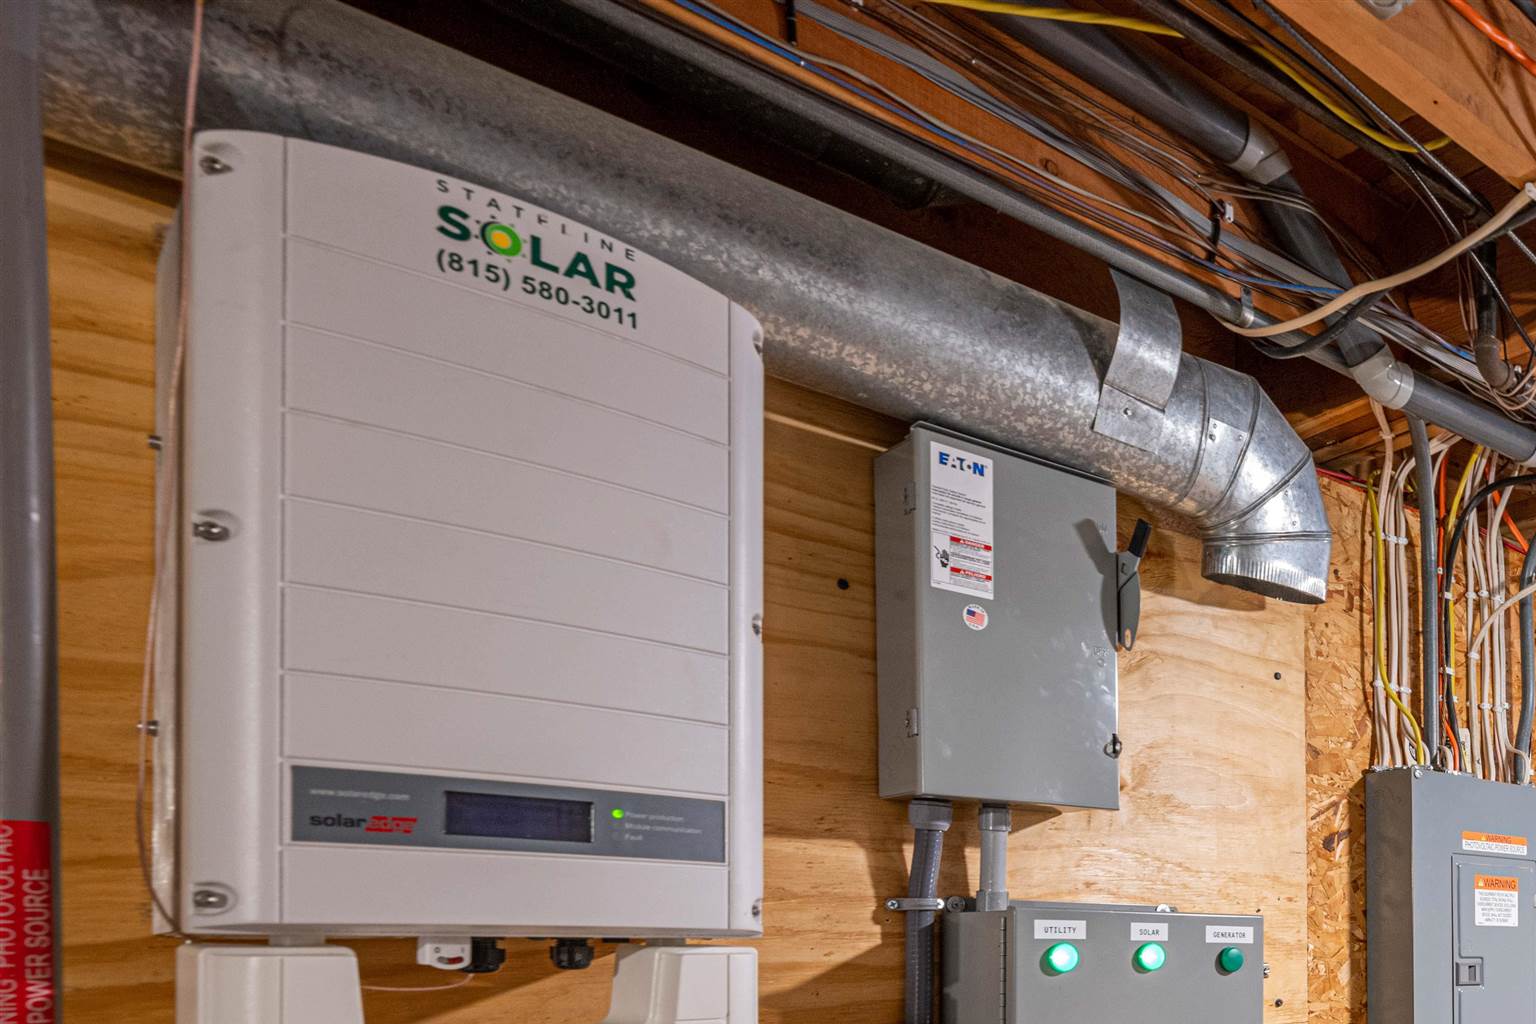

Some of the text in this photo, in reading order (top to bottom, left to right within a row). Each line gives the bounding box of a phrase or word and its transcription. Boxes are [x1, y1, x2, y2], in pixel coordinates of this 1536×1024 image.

[436, 204, 636, 302] SOLAR
[437, 249, 638, 329] (815) 580-3011
[1484, 878, 1517, 889] WARNING
[1043, 926, 1077, 935] UTILITY
[1139, 928, 1160, 937] SOLAR
[1212, 930, 1246, 939] GENERATOR
[21, 868, 52, 1024] POWER SOURCE
